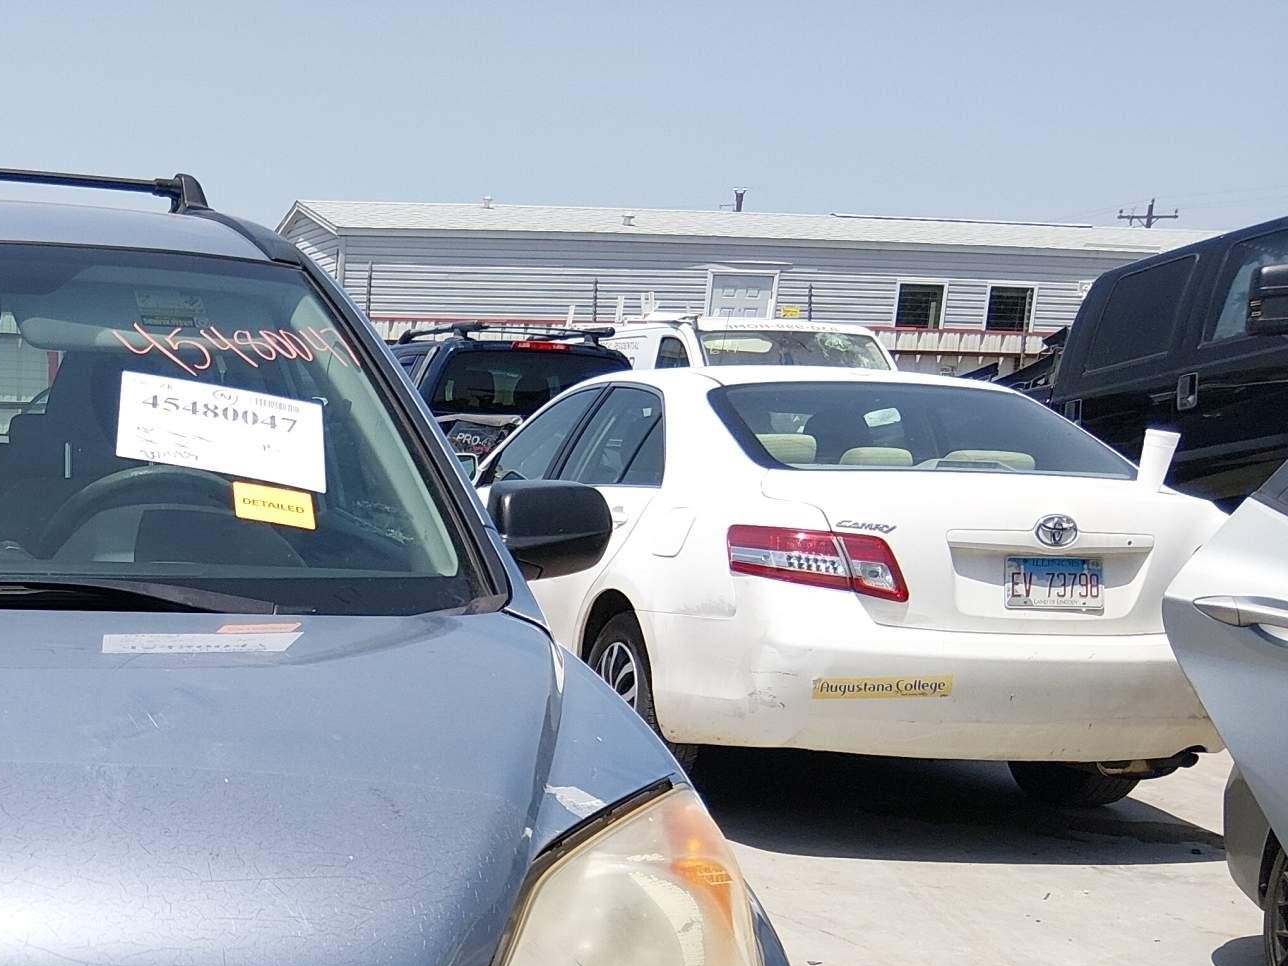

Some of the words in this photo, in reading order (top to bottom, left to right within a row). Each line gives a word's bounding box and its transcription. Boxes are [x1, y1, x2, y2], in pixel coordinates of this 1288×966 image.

[142, 394, 297, 433] 45480047
[242, 497, 305, 514] DETAILED
[1011, 572, 1033, 598] EV
[1046, 572, 1100, 598] 73798
[819, 681, 893, 696] Augustana
[895, 679, 946, 694] College
